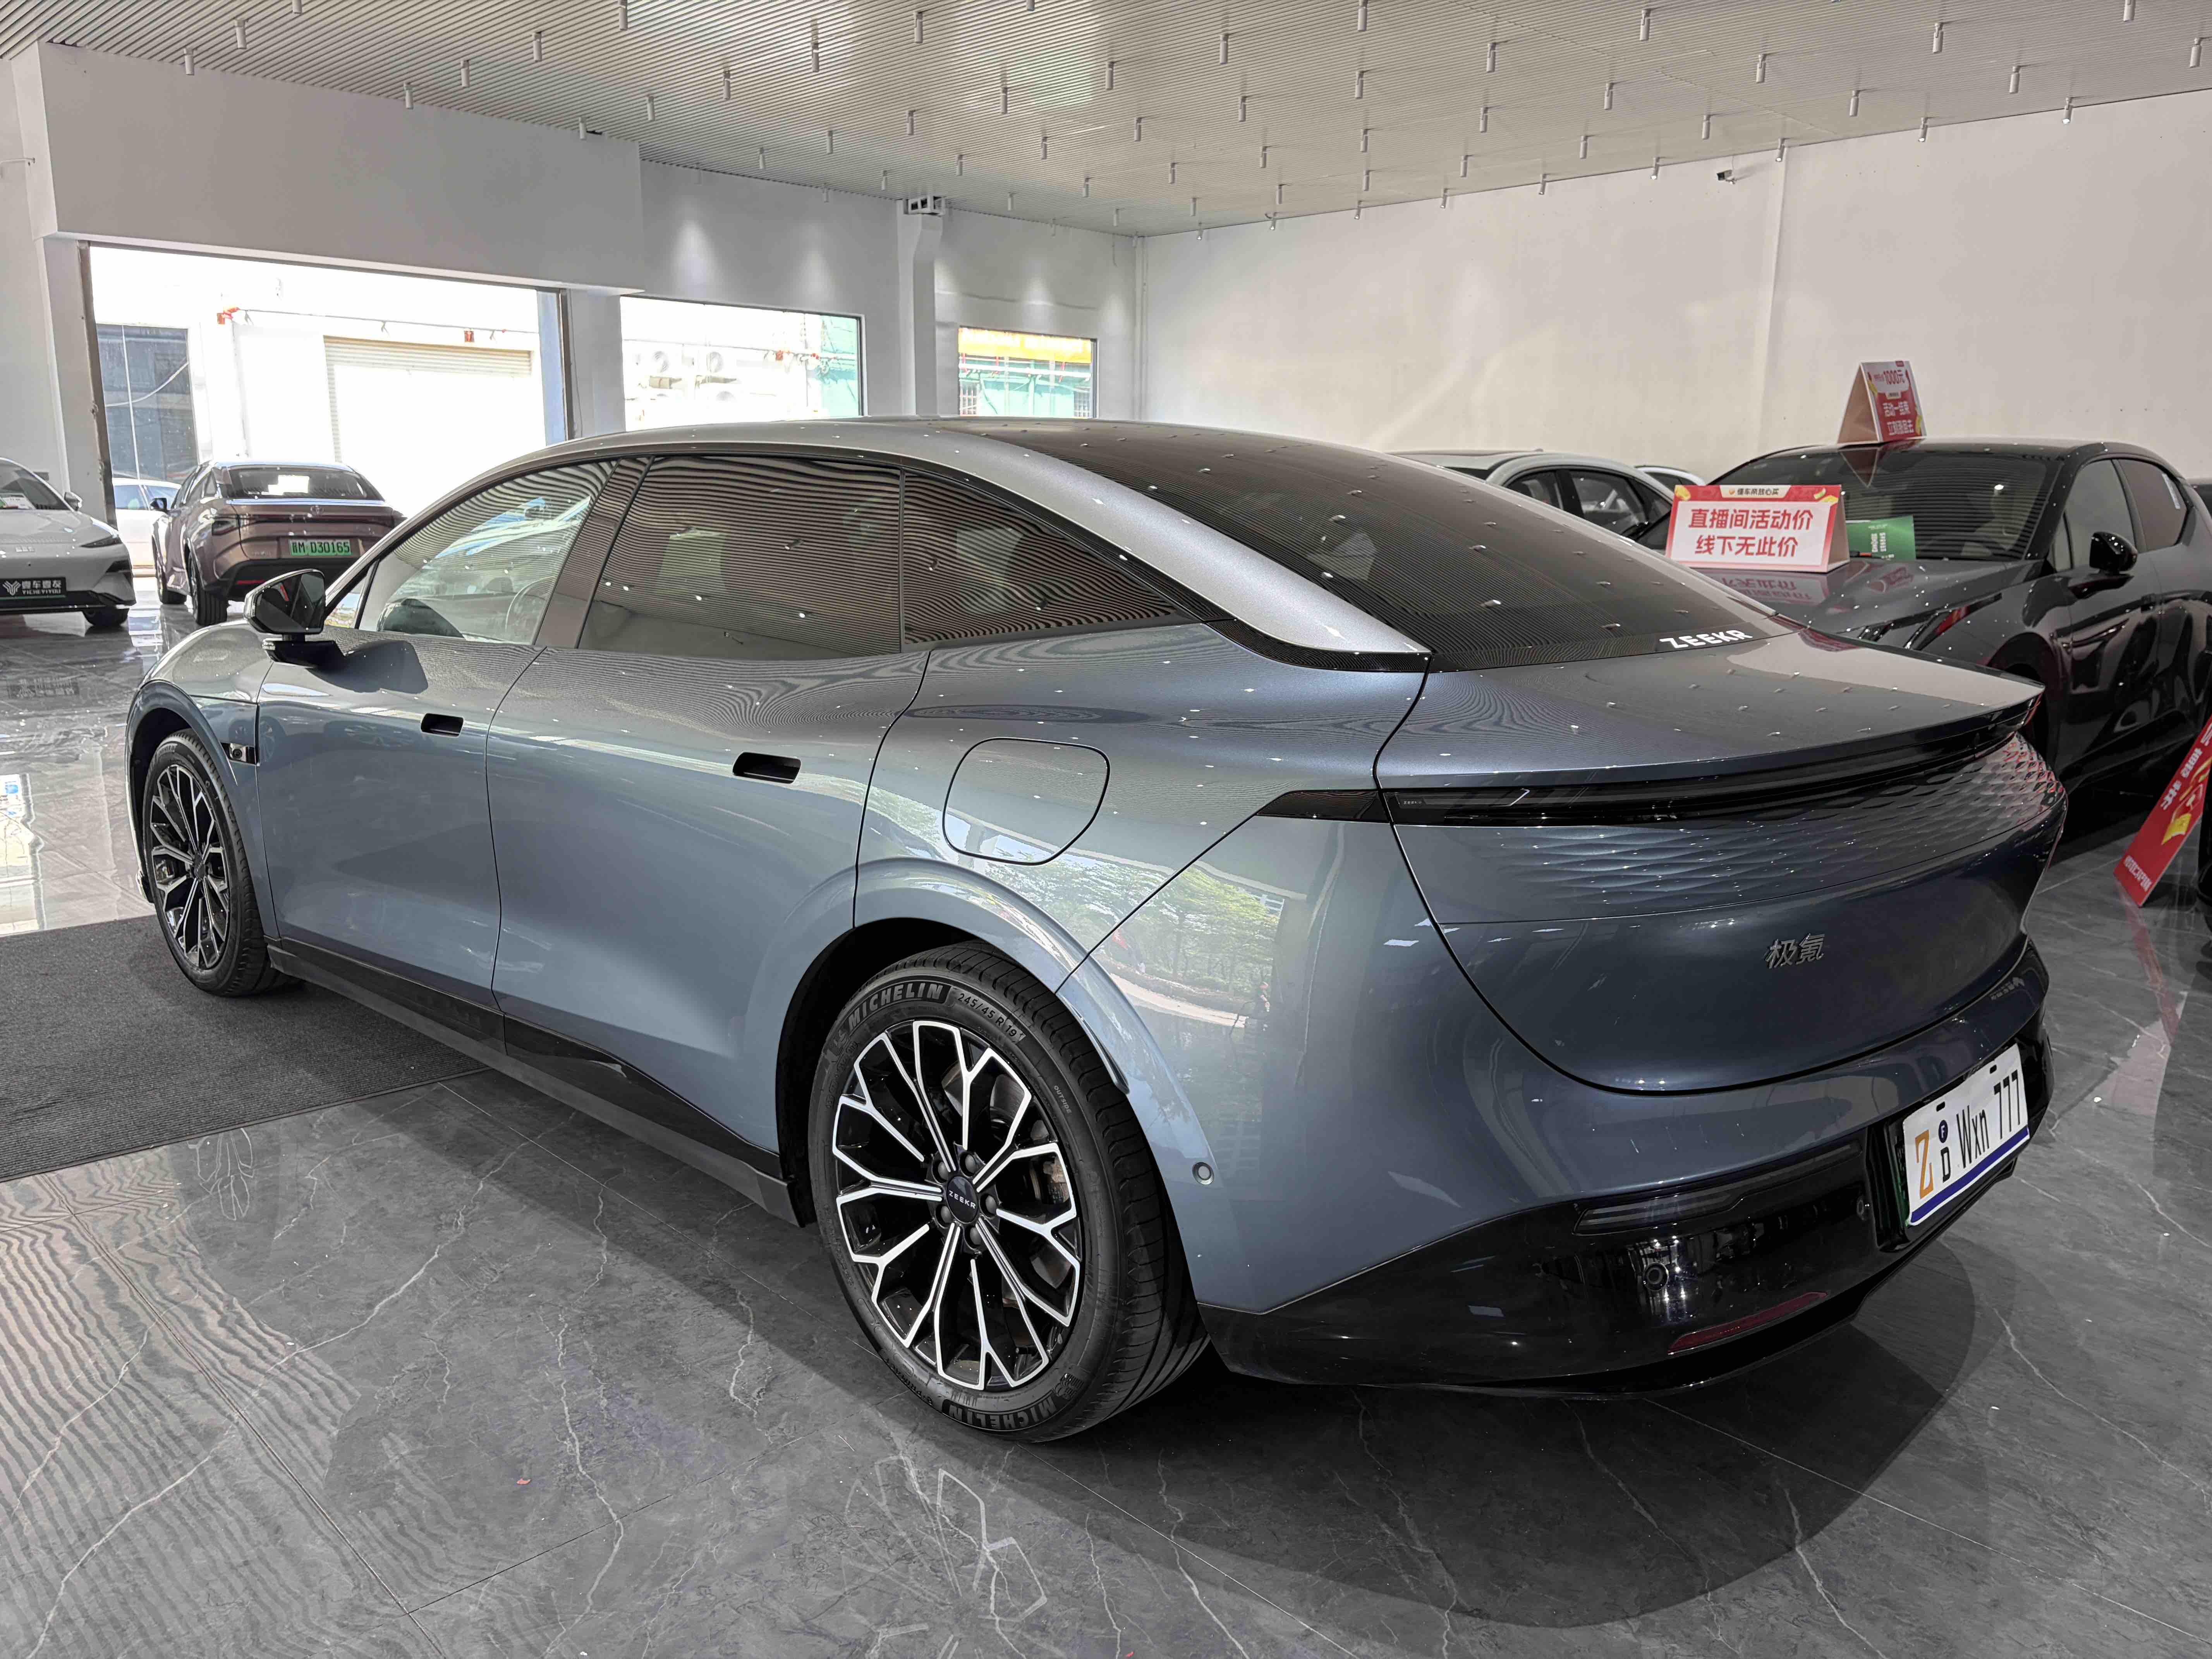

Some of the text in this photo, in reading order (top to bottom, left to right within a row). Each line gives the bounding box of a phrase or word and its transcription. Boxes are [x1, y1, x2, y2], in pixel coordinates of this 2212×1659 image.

[1688, 508, 1813, 531] 直播间活动价
[1694, 535, 1798, 557] 线下无此价
[1659, 629, 1753, 649] ZEEKR
[1765, 933, 1825, 969] 极氪
[848, 982, 943, 1032] MICHELIN
[958, 993, 1017, 1037] 245/45 R 19
[1054, 1085, 1072, 1113] OUTSIDE
[1915, 1129, 1934, 1199] Z
[1993, 1069, 2021, 1140] 777
[949, 1190, 976, 1209] ZEEKR
[948, 1397, 1057, 1430] MICHELIN
